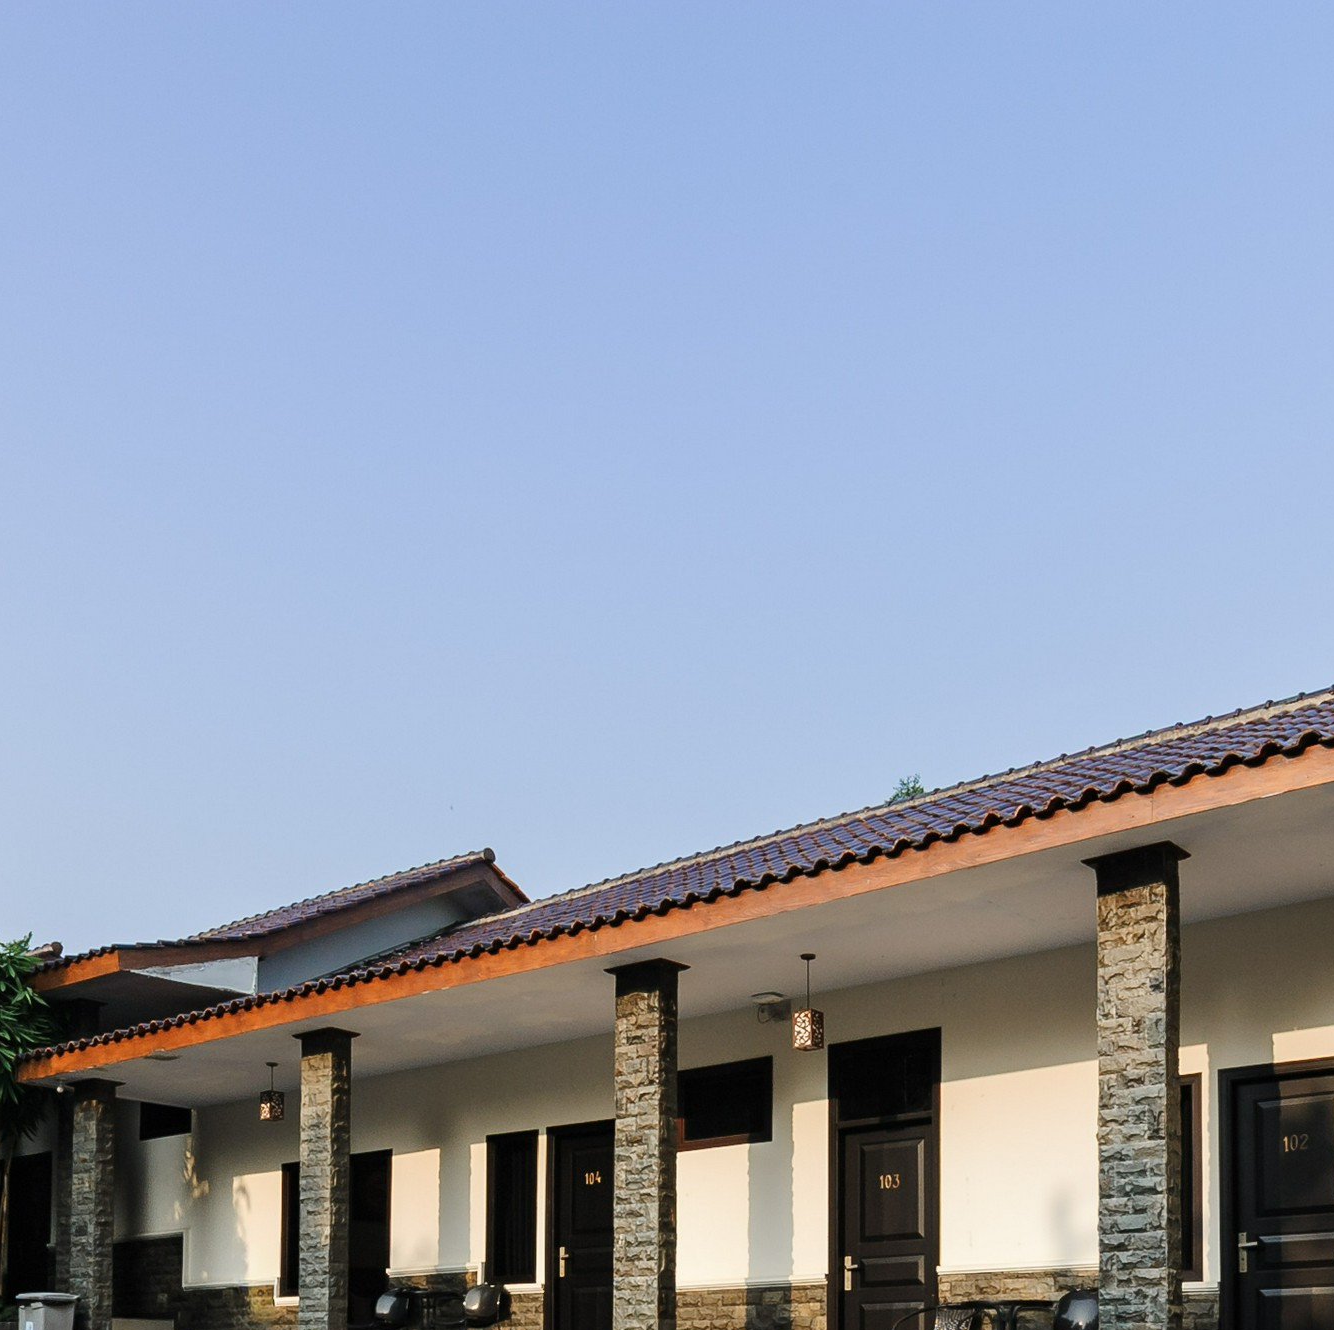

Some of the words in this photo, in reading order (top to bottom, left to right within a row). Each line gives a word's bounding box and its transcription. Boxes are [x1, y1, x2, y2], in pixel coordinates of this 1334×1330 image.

[1282, 1133, 1309, 1153] 102
[584, 1171, 602, 1185] 104
[879, 1173, 900, 1189] 103
